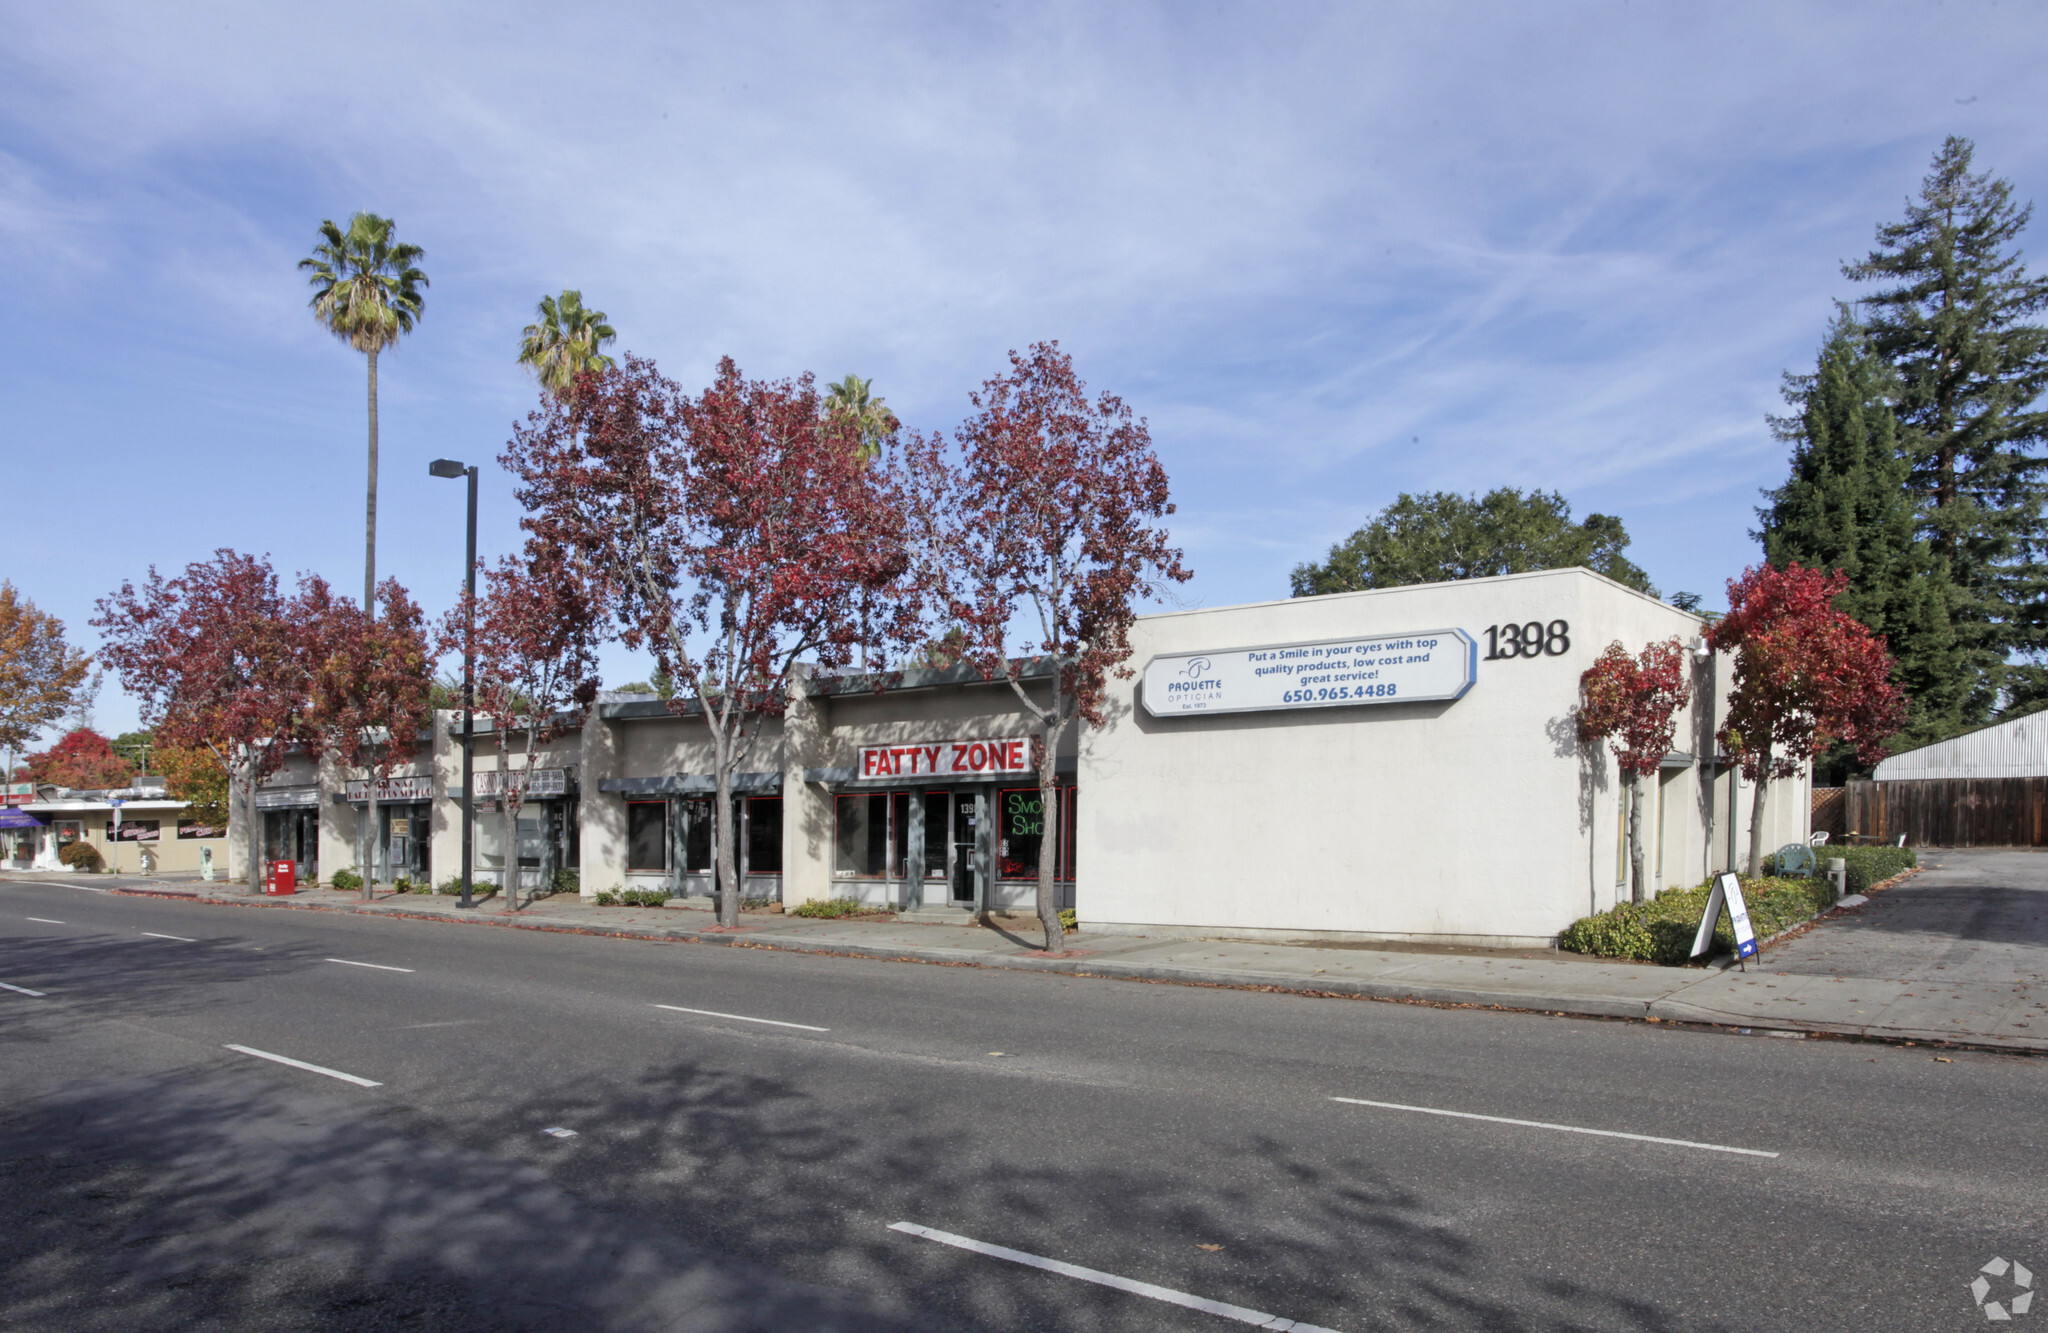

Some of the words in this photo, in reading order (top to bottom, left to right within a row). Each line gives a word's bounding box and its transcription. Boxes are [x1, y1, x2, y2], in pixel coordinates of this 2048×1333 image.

[1248, 652, 1267, 662] Put
[1279, 649, 1309, 660] Smile
[1312, 647, 1323, 657] in
[1326, 645, 1353, 659] your
[1356, 643, 1382, 655] eyes
[1385, 640, 1414, 651] with
[1416, 638, 1438, 649] top
[1483, 619, 1571, 661] 1398
[1255, 663, 1294, 677] quality
[1296, 661, 1351, 675] products,
[1353, 658, 1376, 668] low
[1378, 656, 1402, 666] cost
[1406, 653, 1430, 663] and
[1168, 679, 1222, 693] PAQUETTE
[1300, 675, 1331, 687] great
[1334, 670, 1379, 682] service!
[1168, 692, 1222, 703] OPTICIAN
[1283, 683, 1397, 703] 650.965.4488
[864, 745, 941, 776] FATTY
[951, 741, 1024, 772] ZONE
